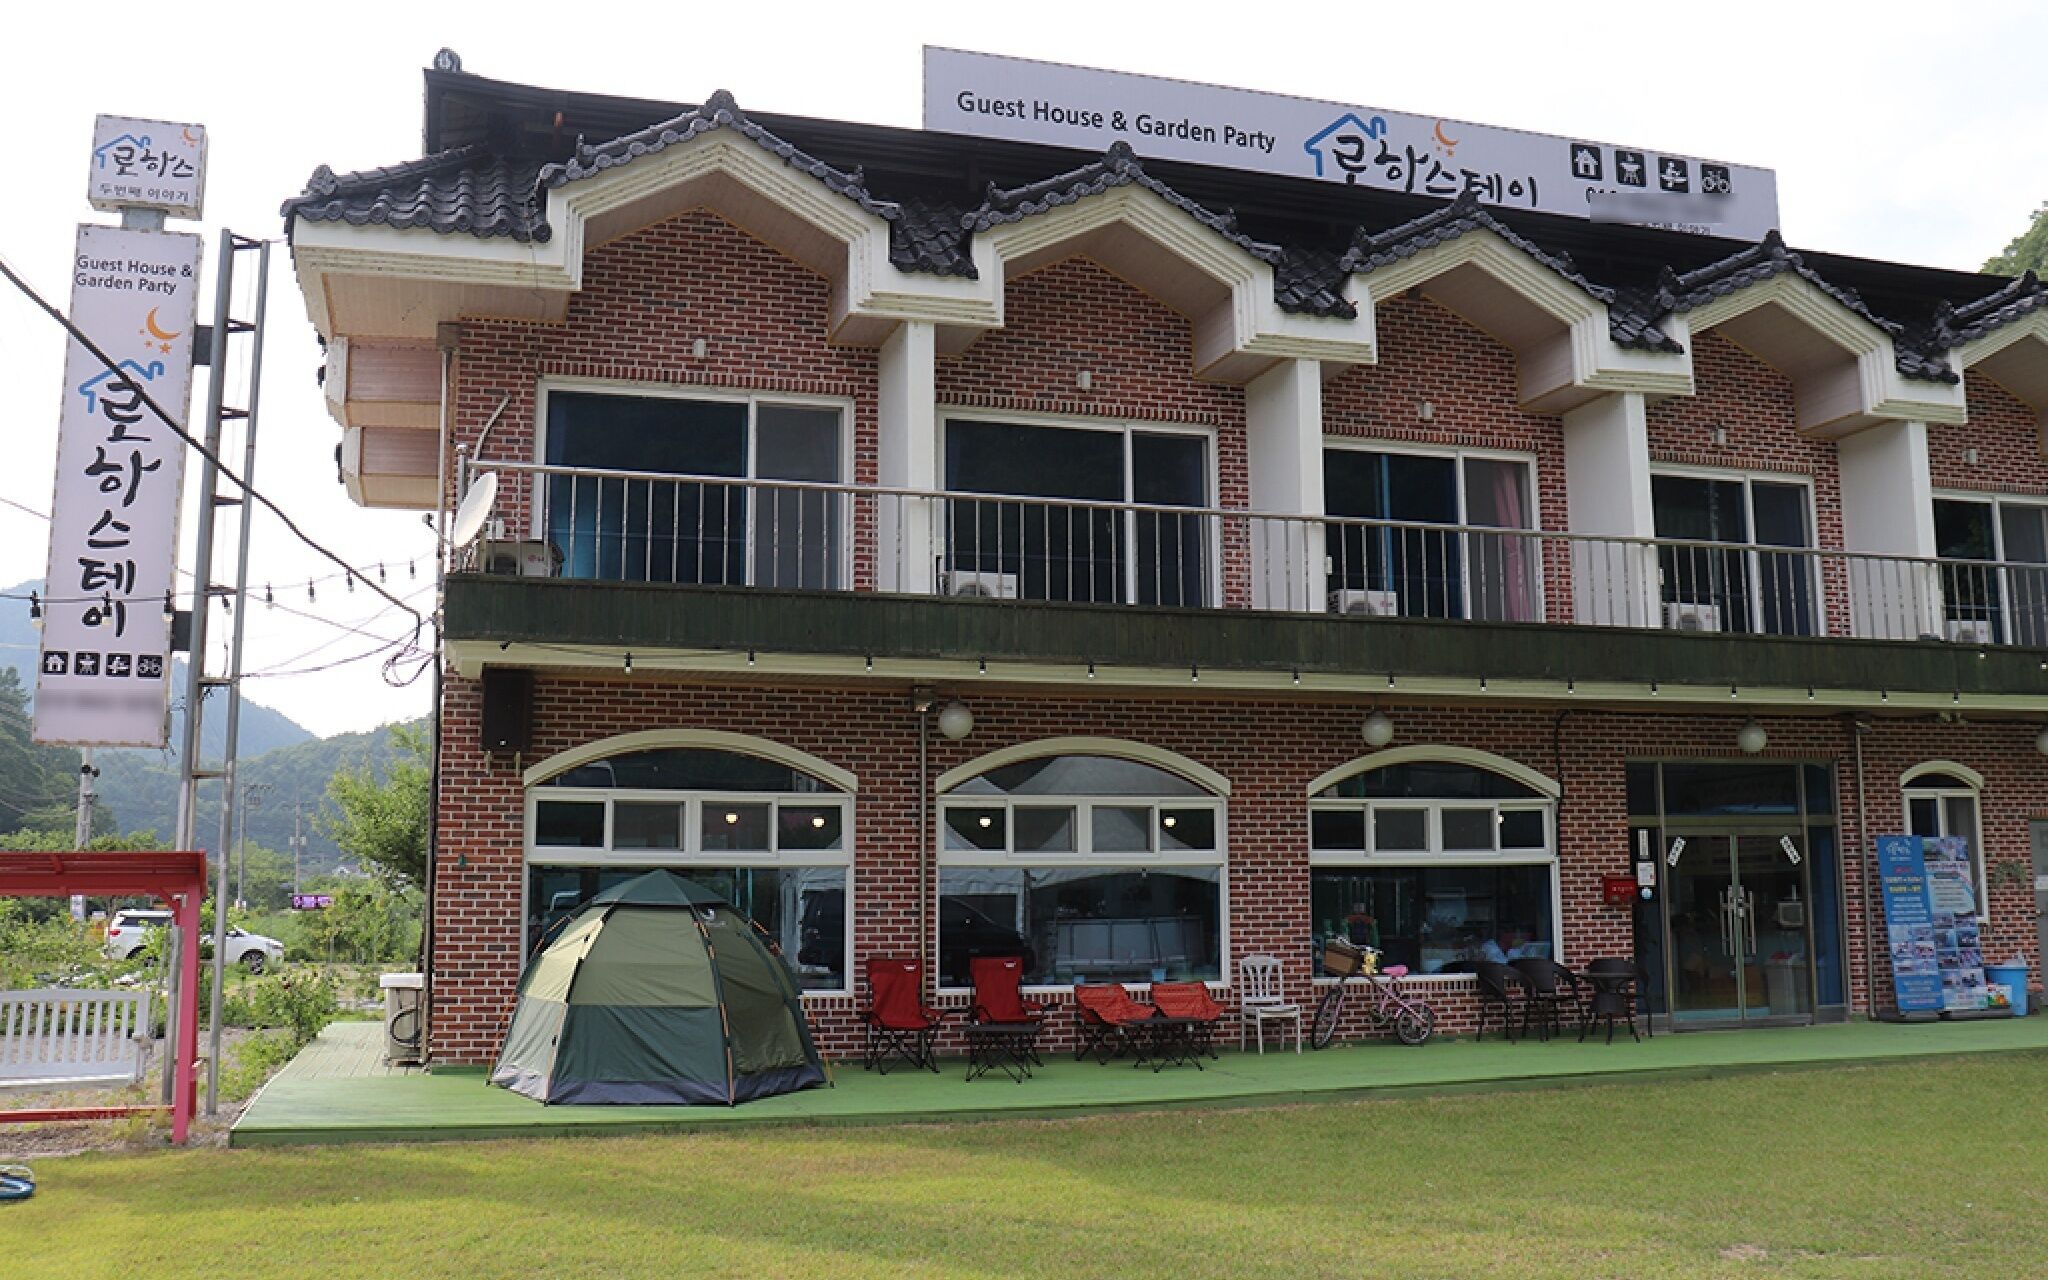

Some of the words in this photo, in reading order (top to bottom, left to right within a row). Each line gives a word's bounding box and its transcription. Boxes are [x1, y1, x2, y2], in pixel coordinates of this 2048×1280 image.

[957, 91, 1025, 119] Guest
[1033, 101, 1103, 129] House
[1111, 111, 1128, 131] &
[1136, 114, 1215, 143] Garden
[1223, 125, 1276, 154] Party
[114, 146, 194, 178] 로하스
[1332, 135, 1537, 207] 로하스테이
[147, 188, 189, 202] 이야기
[77, 255, 123, 272] Guest
[128, 259, 176, 277] House
[181, 264, 193, 278] &
[75, 272, 133, 291] Garden
[138, 278, 177, 296] Party
[78, 380, 162, 638] 로하스테이
